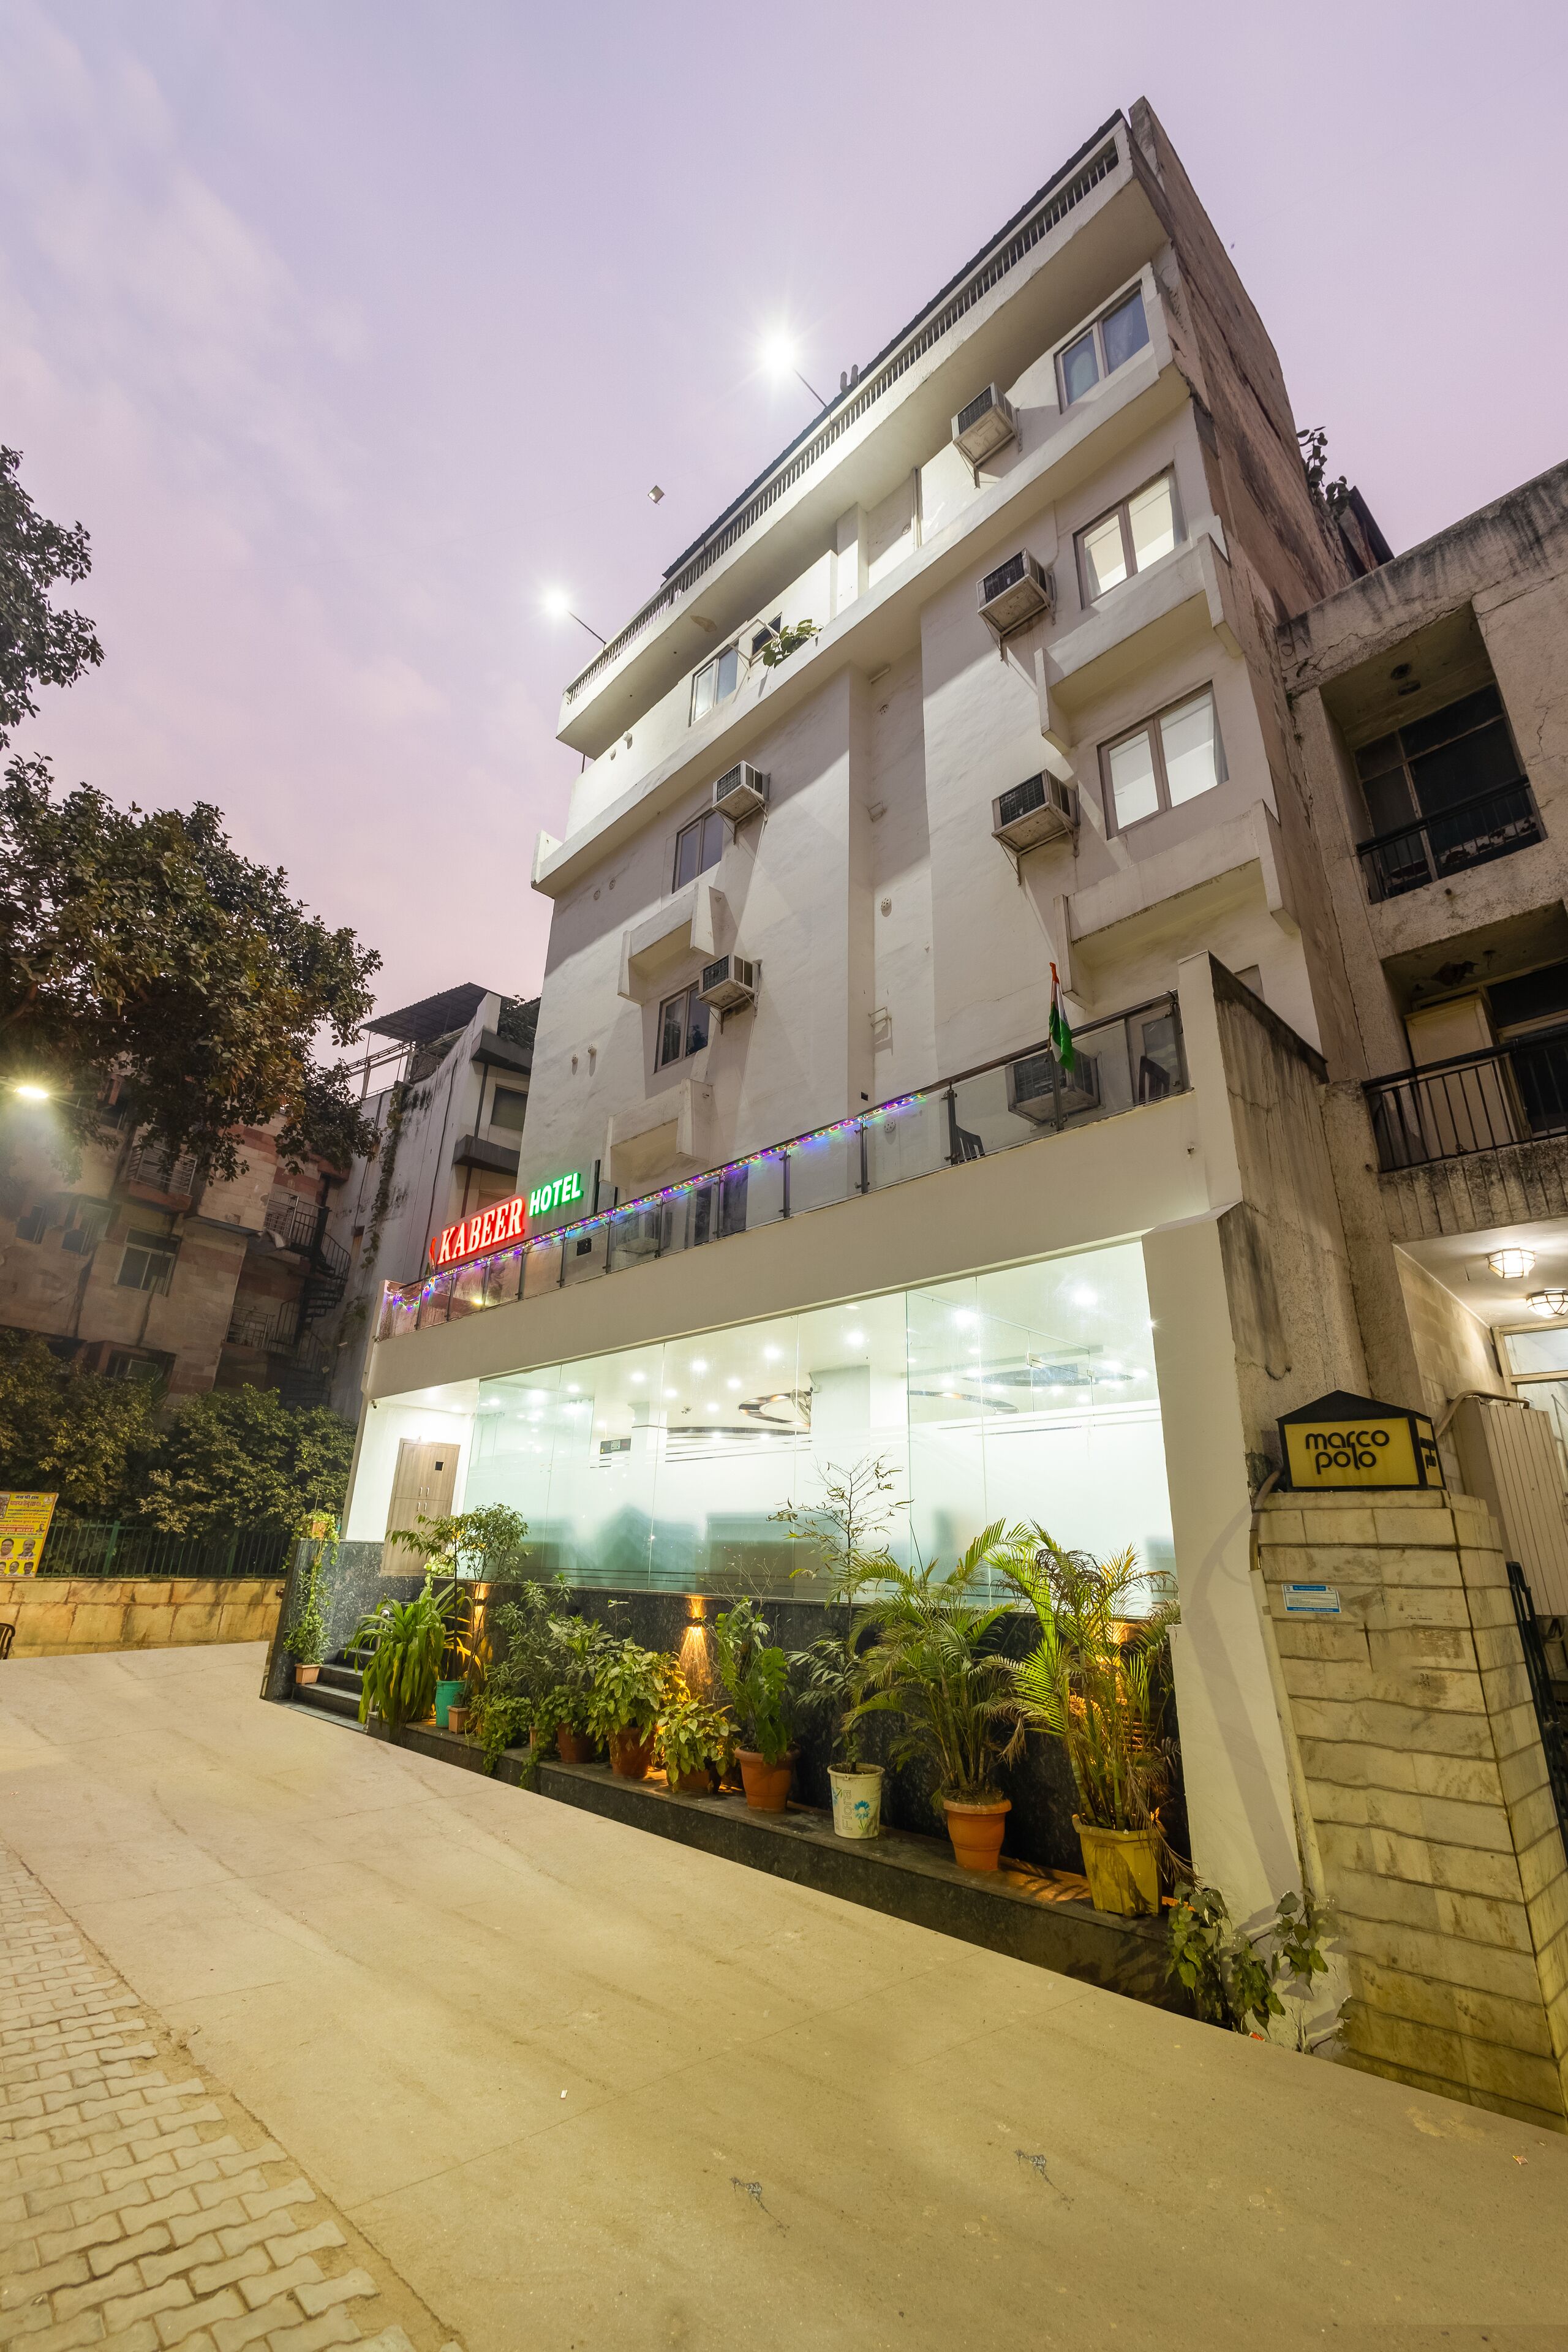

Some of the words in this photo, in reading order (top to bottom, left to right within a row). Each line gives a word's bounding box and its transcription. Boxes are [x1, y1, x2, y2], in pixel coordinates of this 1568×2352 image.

[437, 1199, 524, 1264] KABEER
[529, 1172, 582, 1216] HOTEL
[1305, 1430, 1389, 1450] marco
[1315, 1442, 1376, 1475] polo
[842, 1790, 853, 1830] Flora
